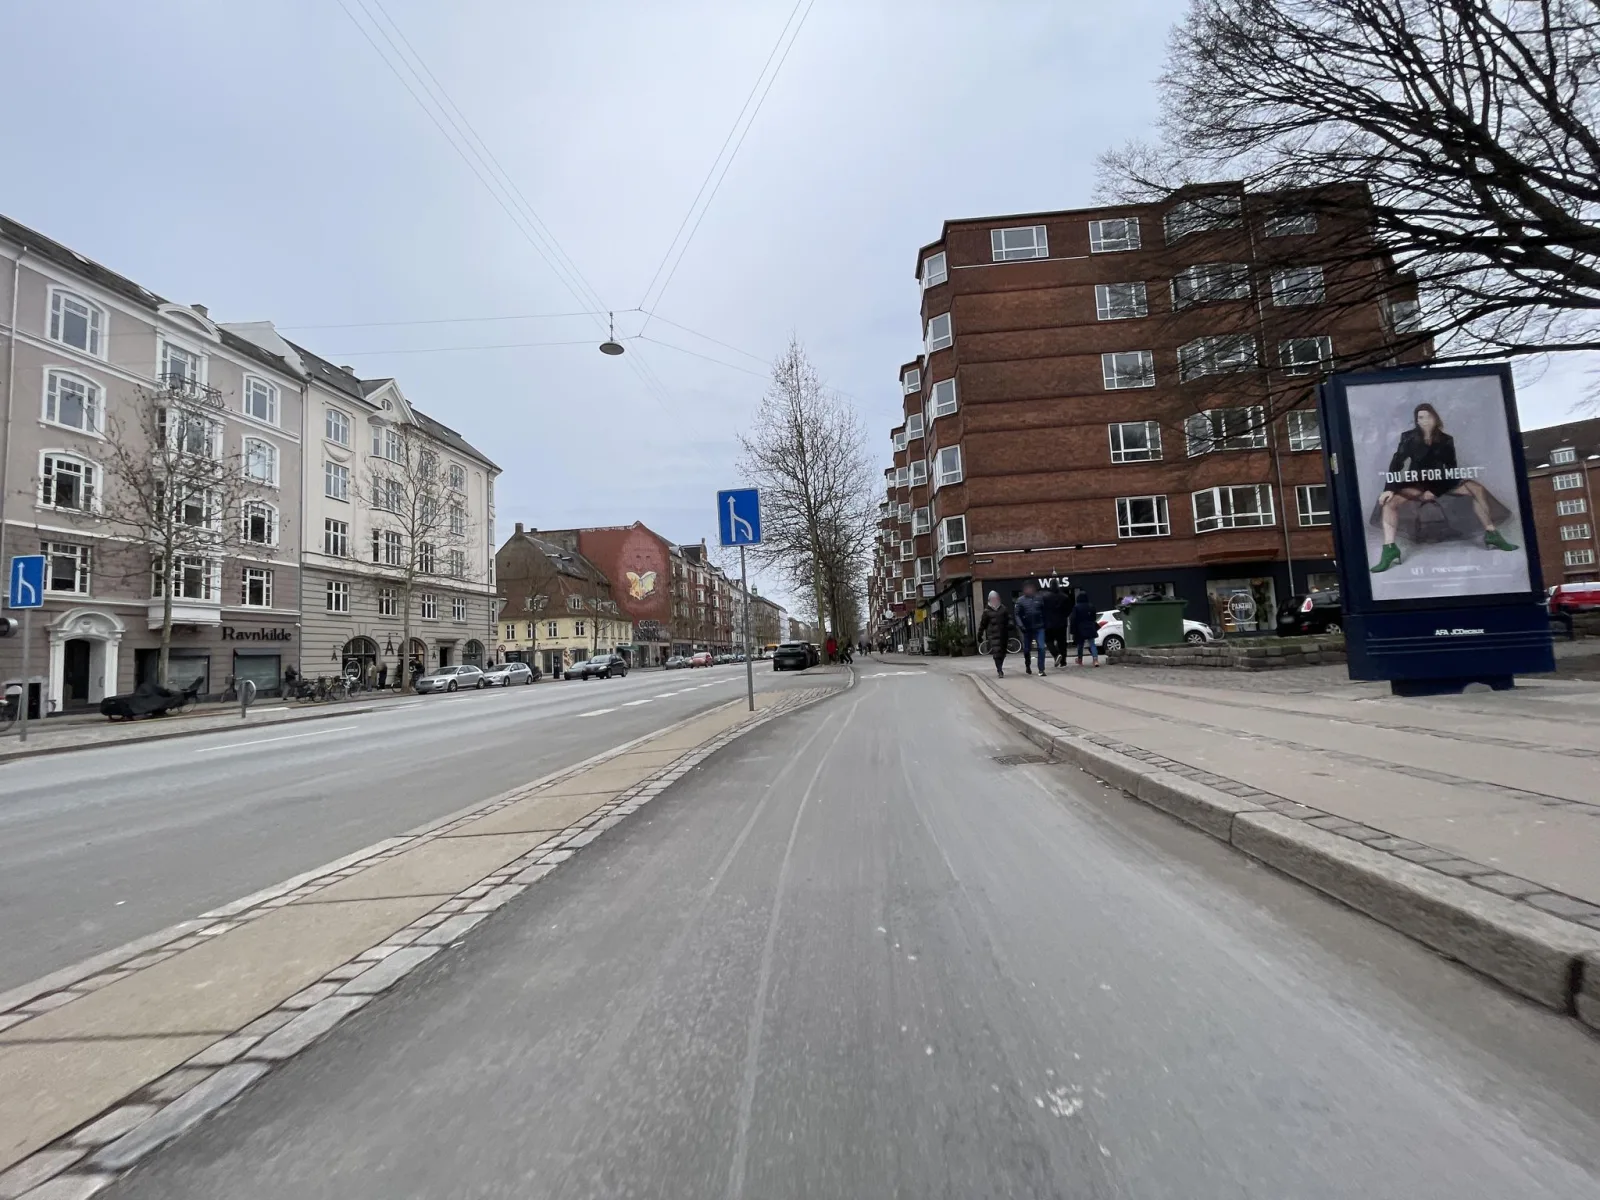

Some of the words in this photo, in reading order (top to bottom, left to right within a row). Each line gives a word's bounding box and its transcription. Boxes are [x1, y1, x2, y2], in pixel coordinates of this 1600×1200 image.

[1404, 470, 1419, 483] ER
[1421, 468, 1443, 481] FOR
[1038, 576, 1070, 589] WLS
[221, 626, 292, 641] Ravnkilde
